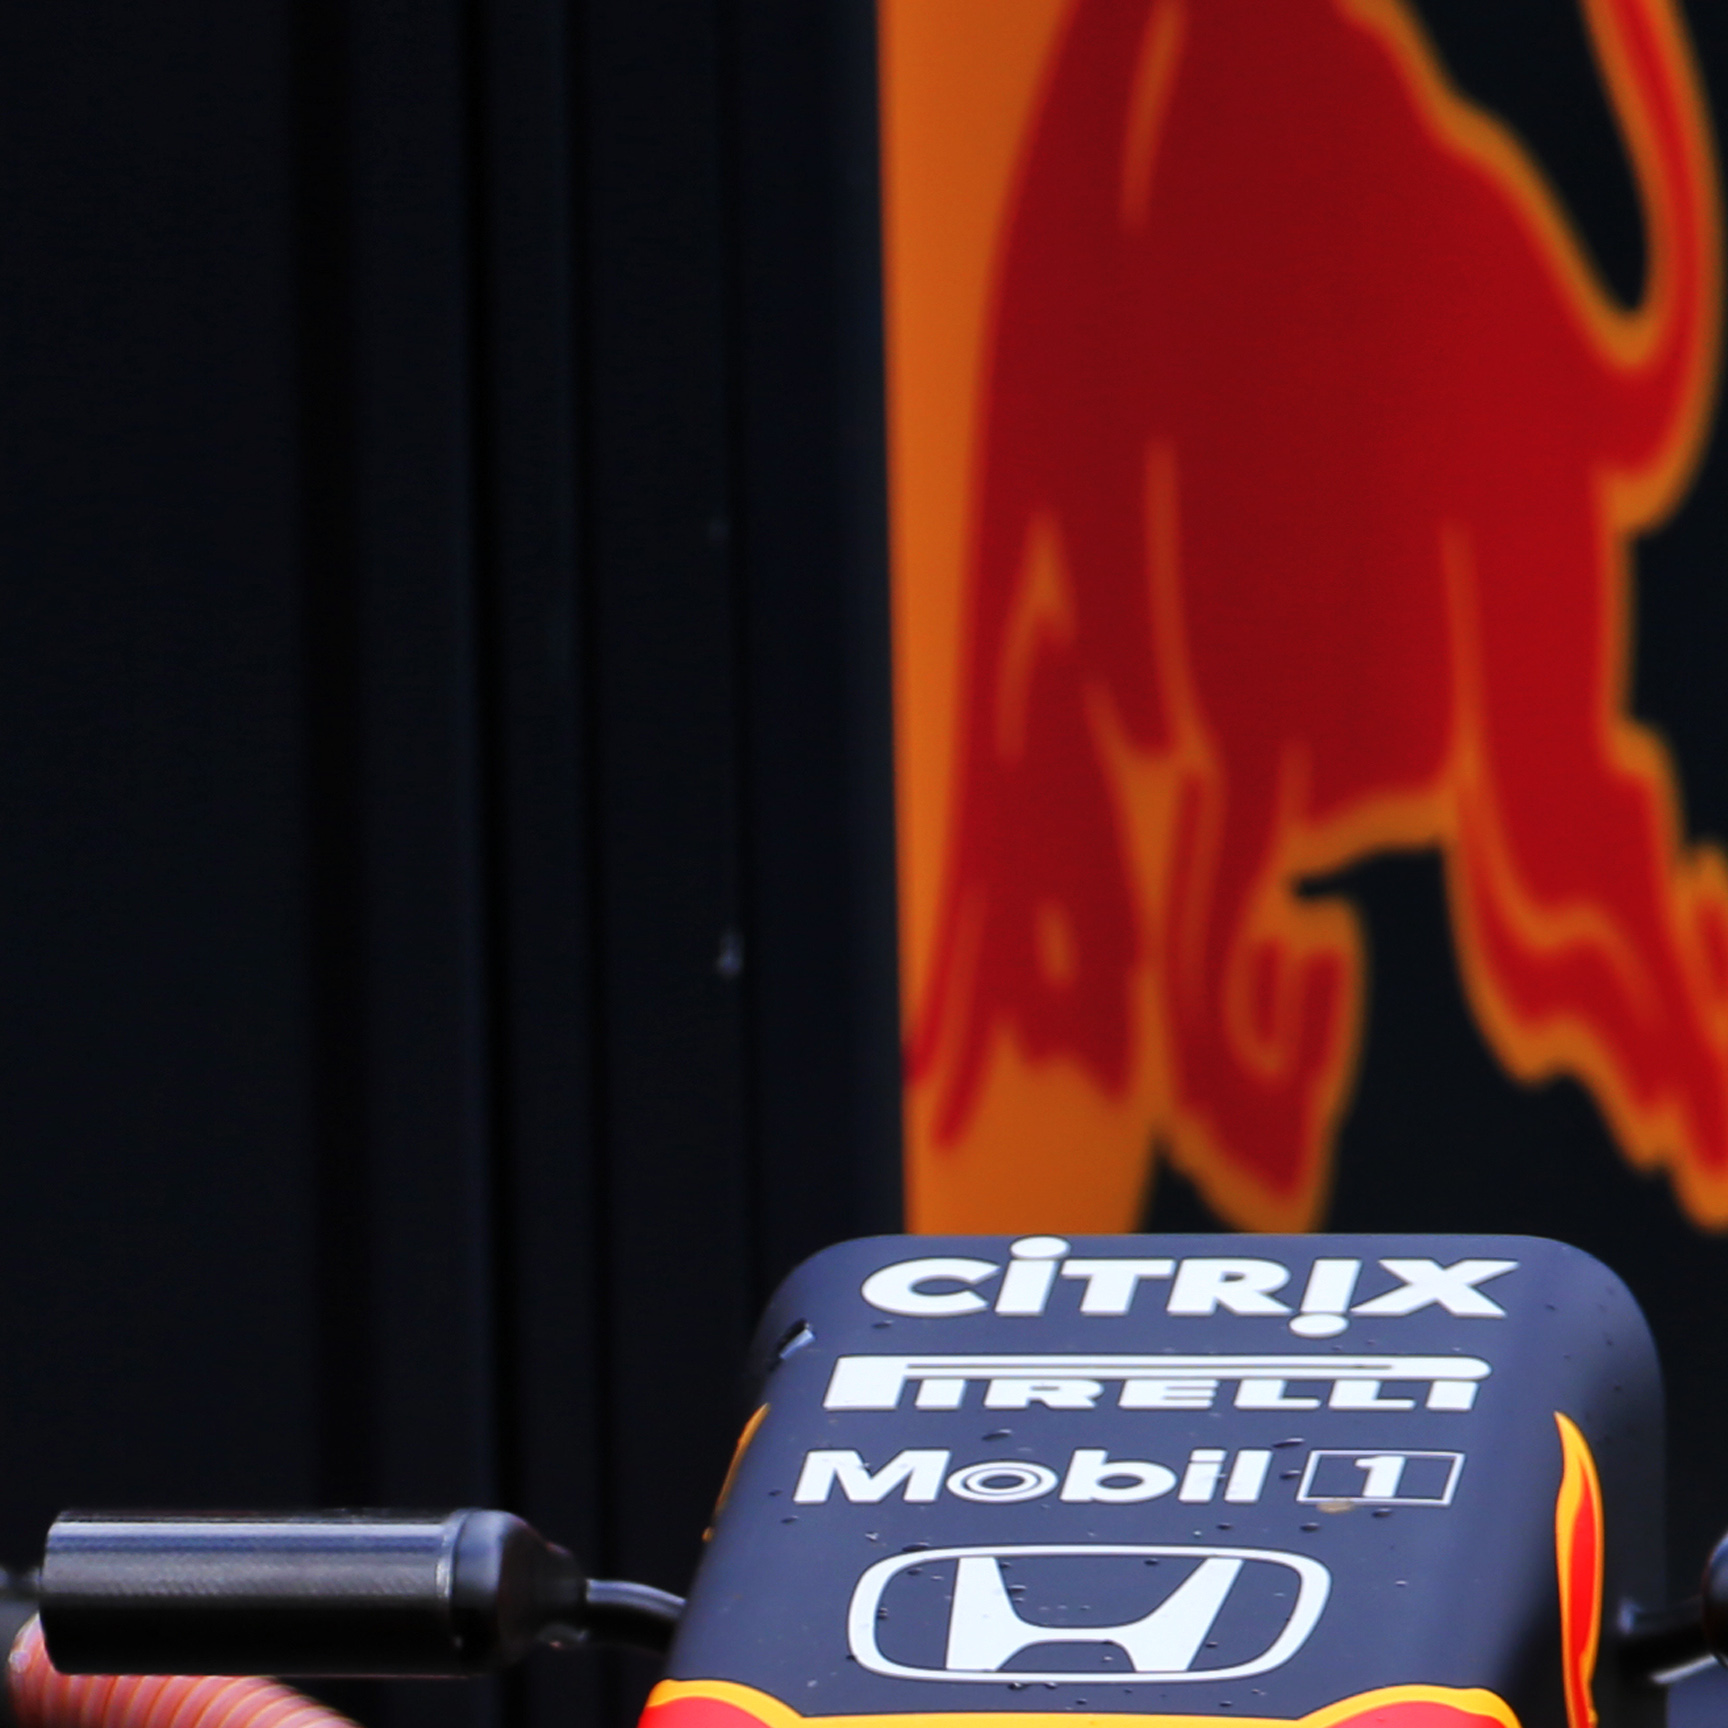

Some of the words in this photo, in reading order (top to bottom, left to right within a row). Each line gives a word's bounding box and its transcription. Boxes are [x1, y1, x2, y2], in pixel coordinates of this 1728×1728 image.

[822, 1354, 1491, 1411] PIRELLI
[793, 1448, 1271, 1504] Mobil
[1352, 1455, 1405, 1499] 1
